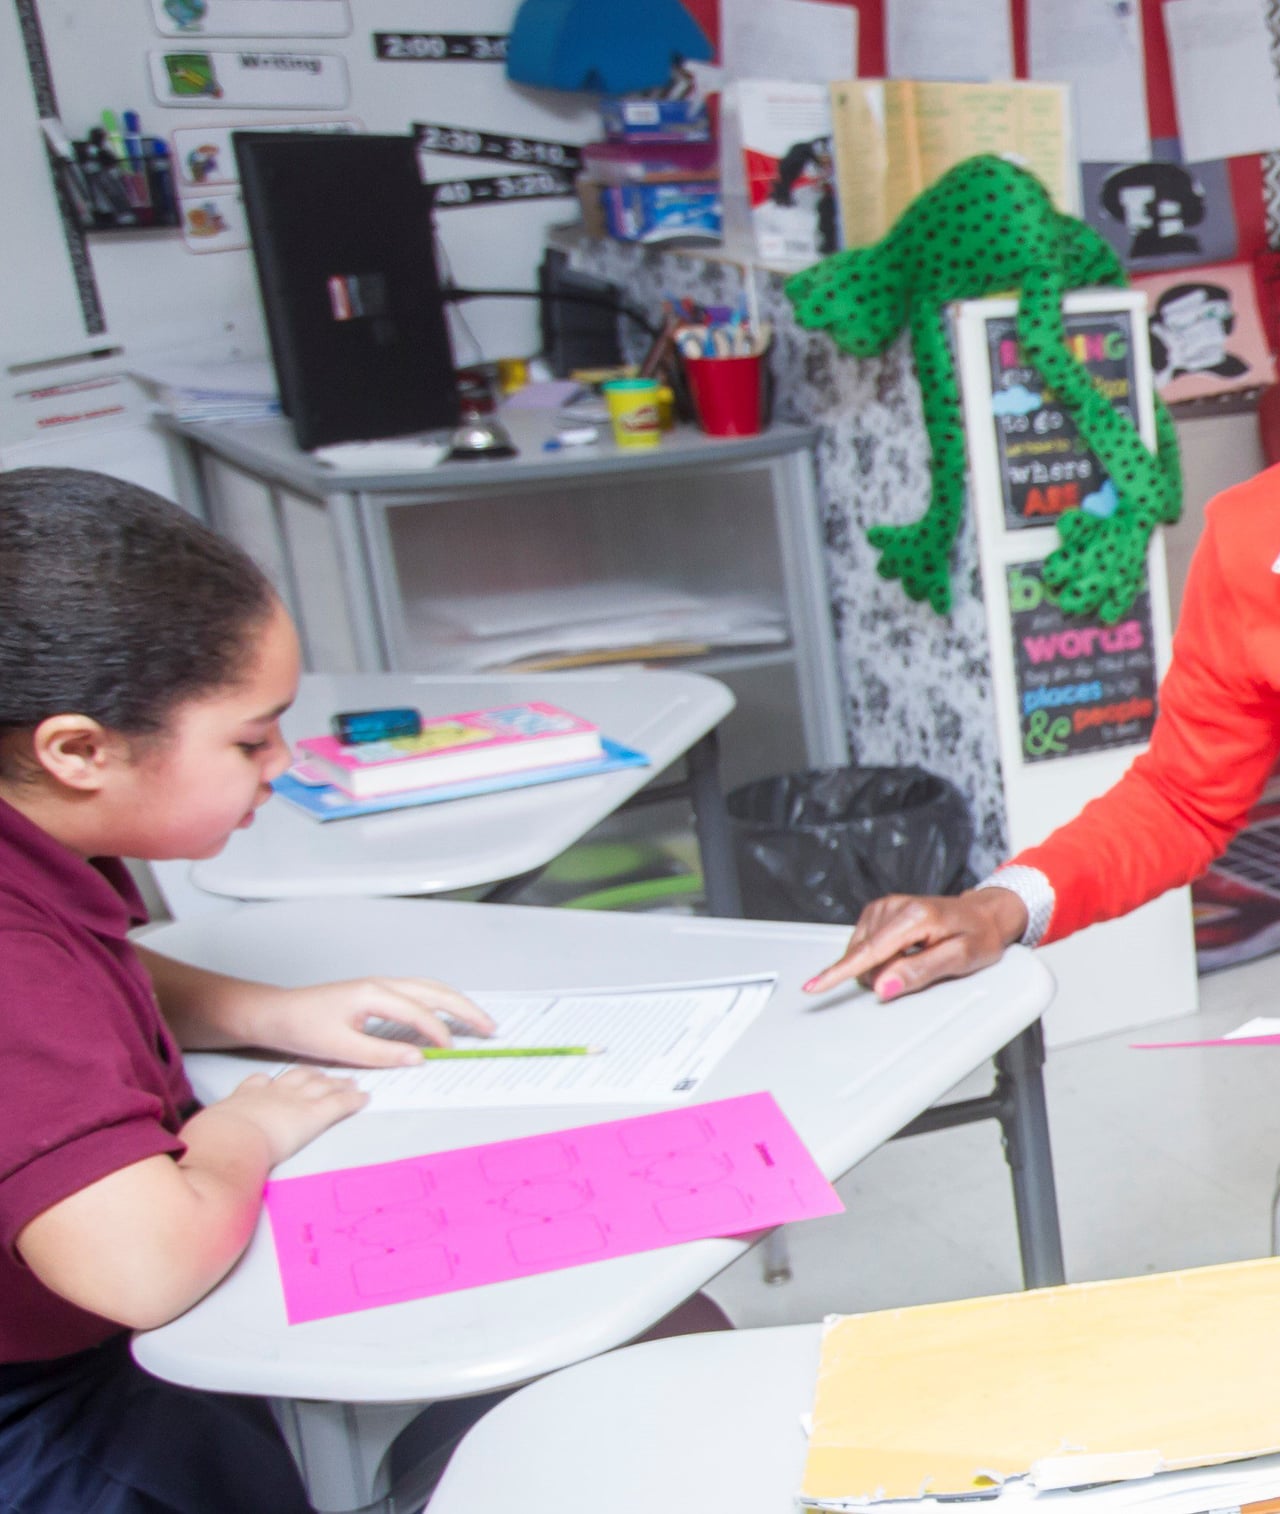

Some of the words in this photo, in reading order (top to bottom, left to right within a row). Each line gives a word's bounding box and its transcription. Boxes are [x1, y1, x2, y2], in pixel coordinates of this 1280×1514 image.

[382, 35, 447, 59] 2:00
[470, 37, 507, 59] 3:0
[240, 53, 323, 75] Writing
[421, 127, 482, 154] 2:30
[1008, 458, 1094, 486] where
[1022, 620, 1145, 665] words
[1023, 680, 1103, 717] places
[1025, 708, 1072, 757] &
